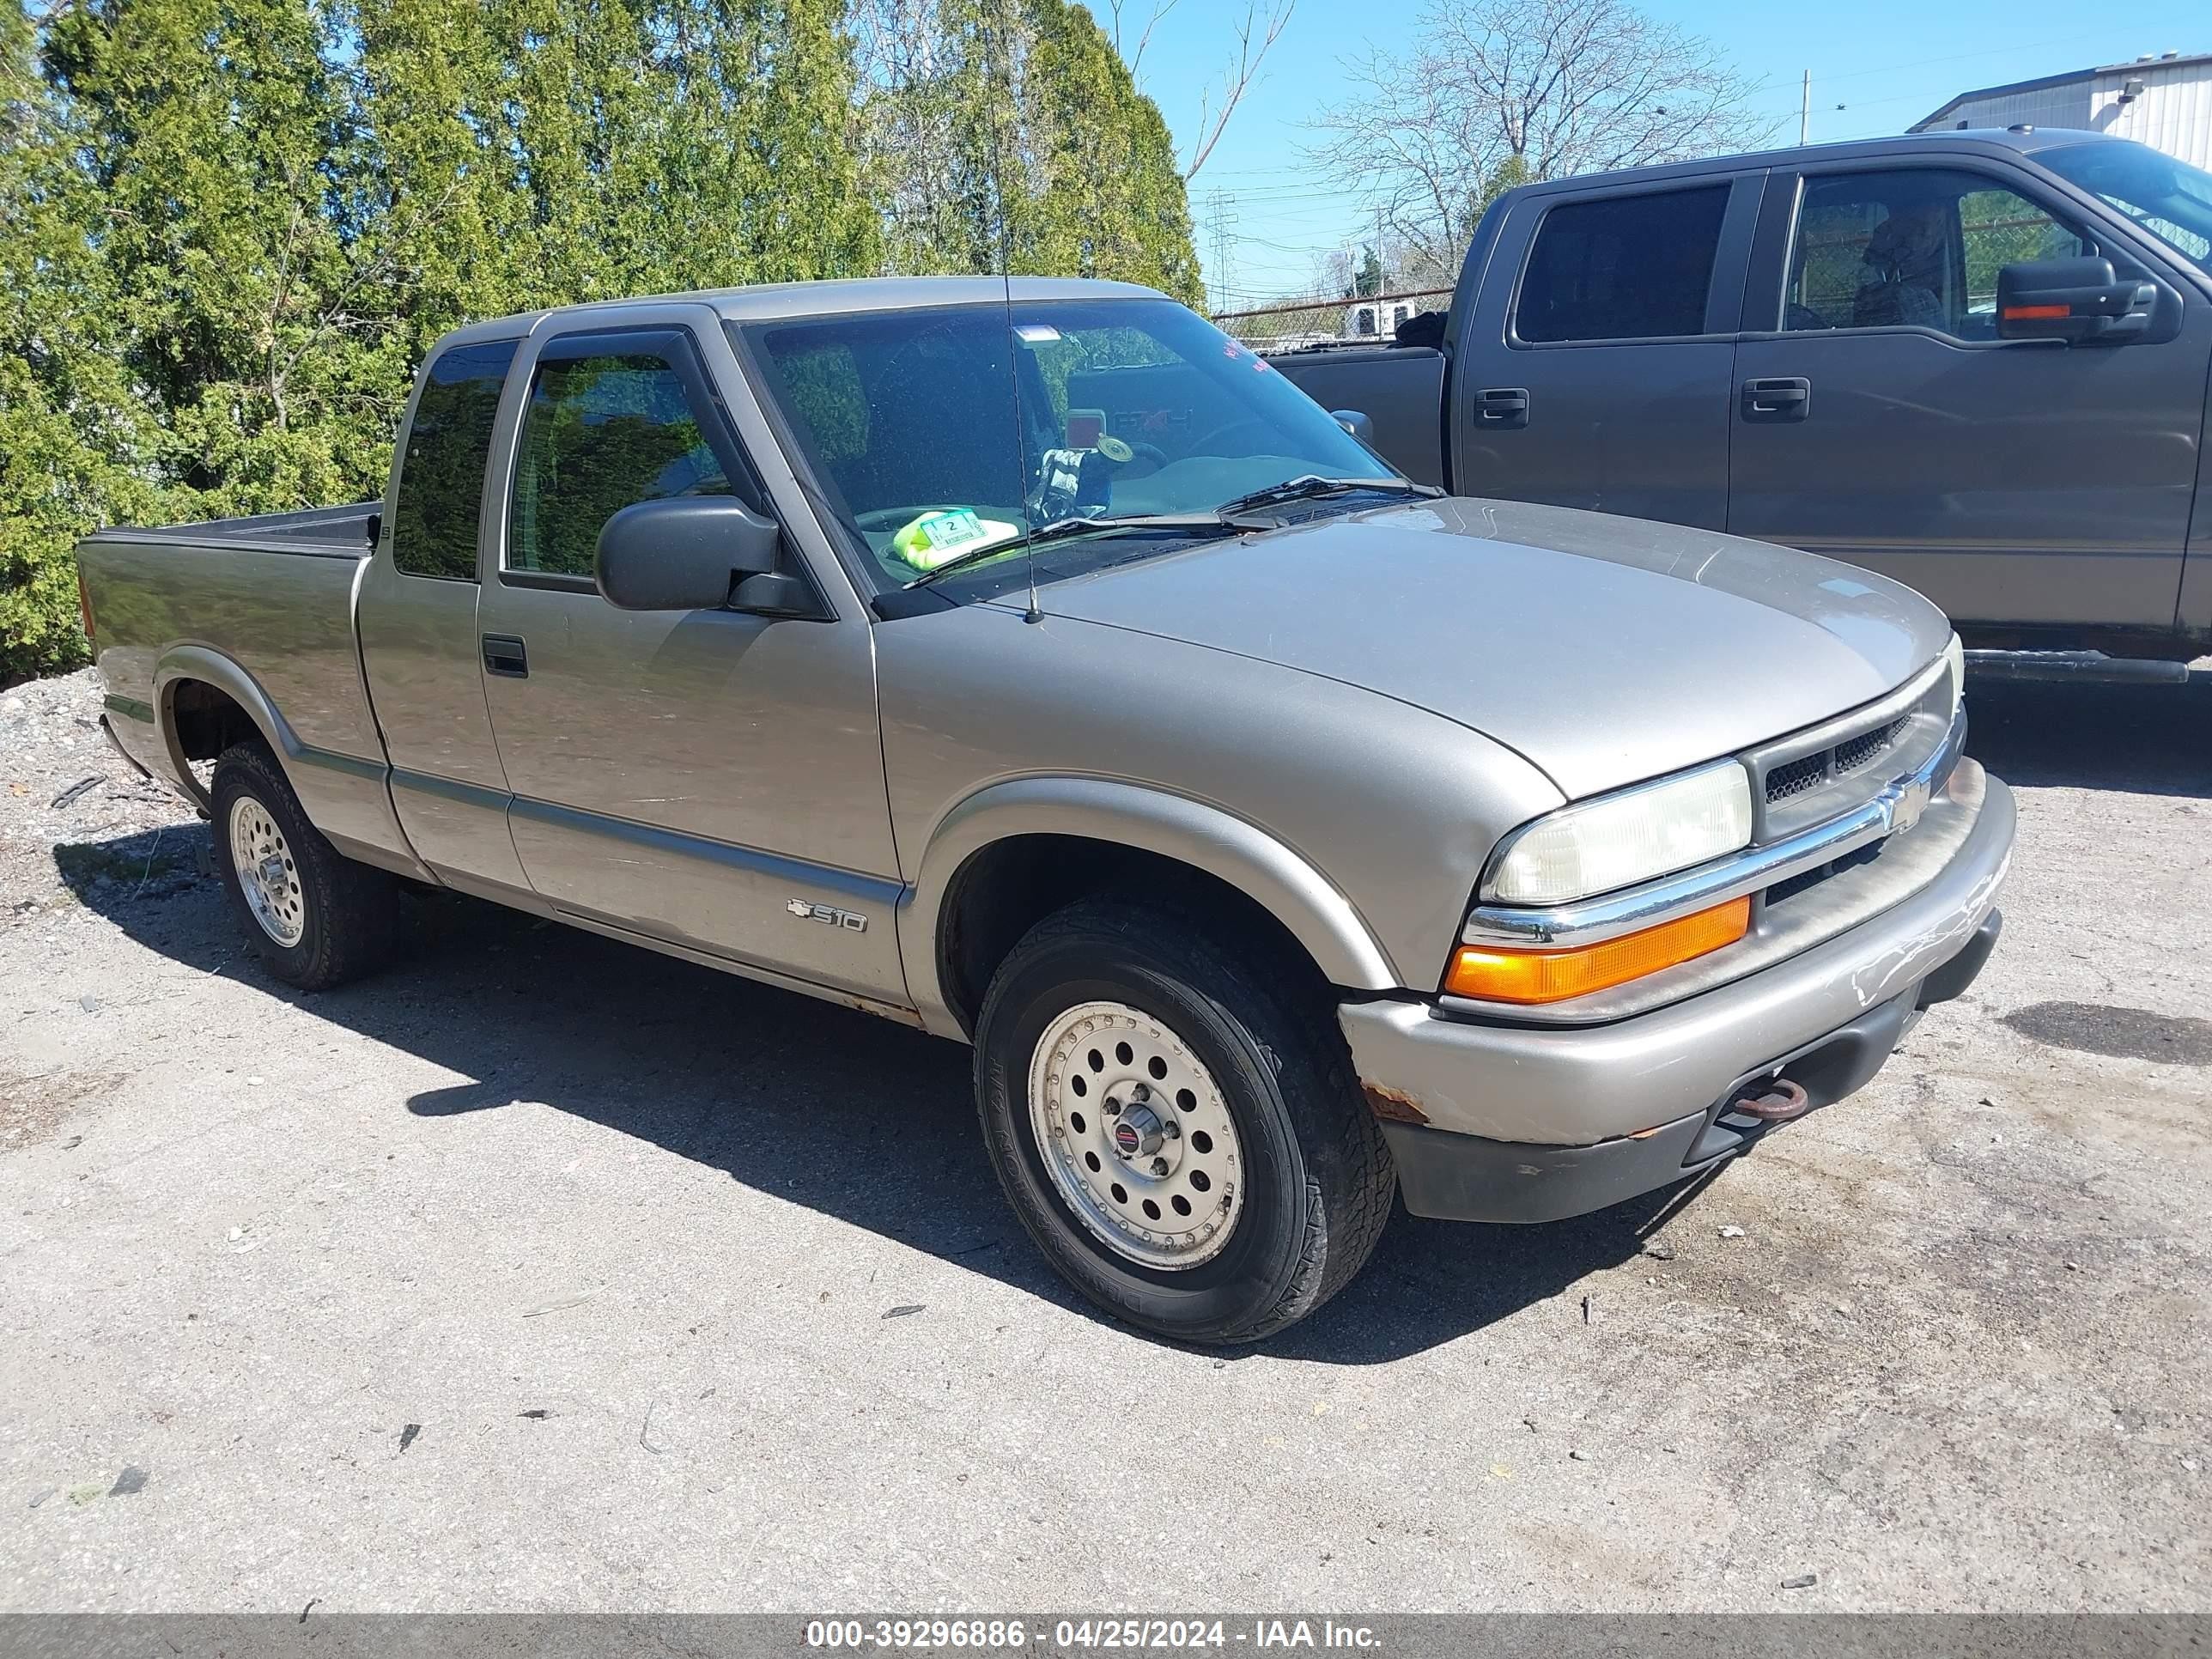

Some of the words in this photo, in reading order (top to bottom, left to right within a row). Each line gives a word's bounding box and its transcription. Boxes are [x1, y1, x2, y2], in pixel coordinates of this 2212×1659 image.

[1113, 409, 1194, 433] FX4
[945, 521, 958, 532] 2
[812, 902, 868, 933] S10
